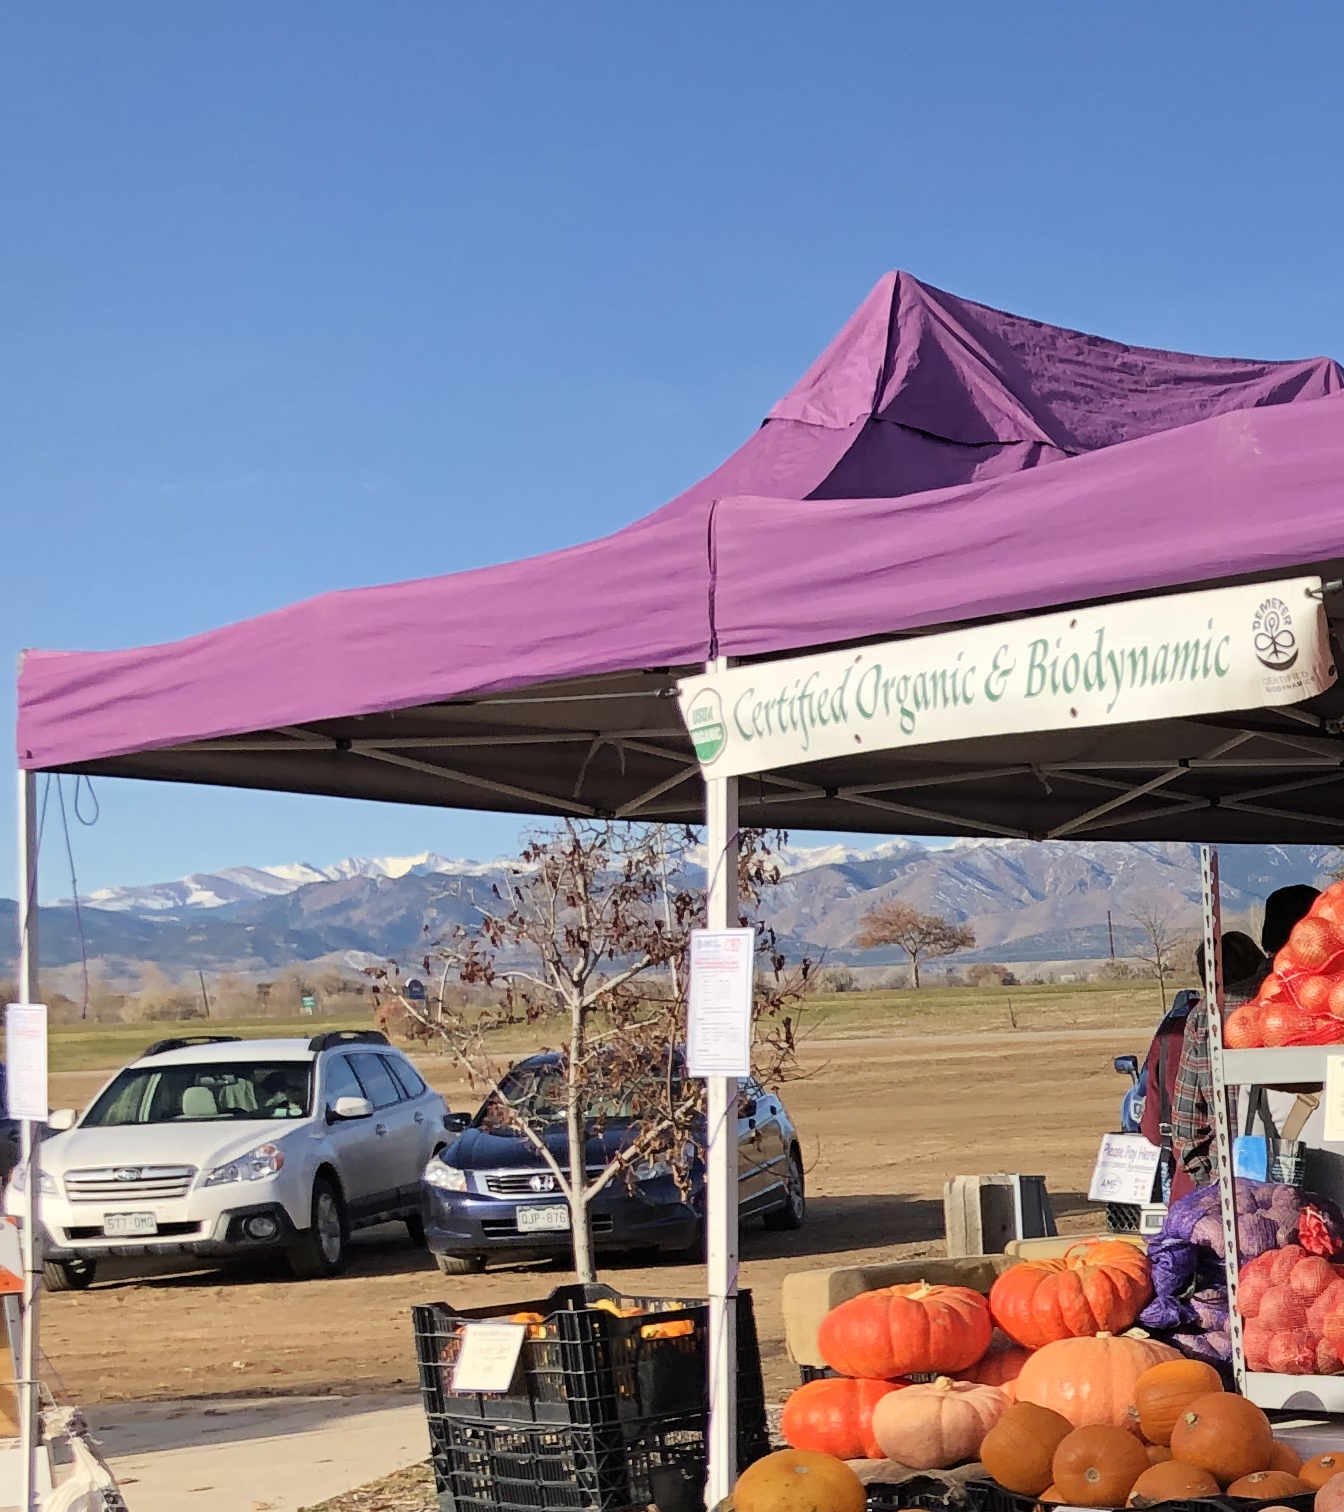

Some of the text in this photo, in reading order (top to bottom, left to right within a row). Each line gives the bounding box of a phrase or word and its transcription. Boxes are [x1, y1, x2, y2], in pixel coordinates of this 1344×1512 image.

[1252, 597, 1292, 631] DEMETER
[733, 617, 1232, 752] Certified Organic & Biodynamic
[1262, 670, 1308, 686] CERTIFIED
[692, 706, 714, 725] USDA
